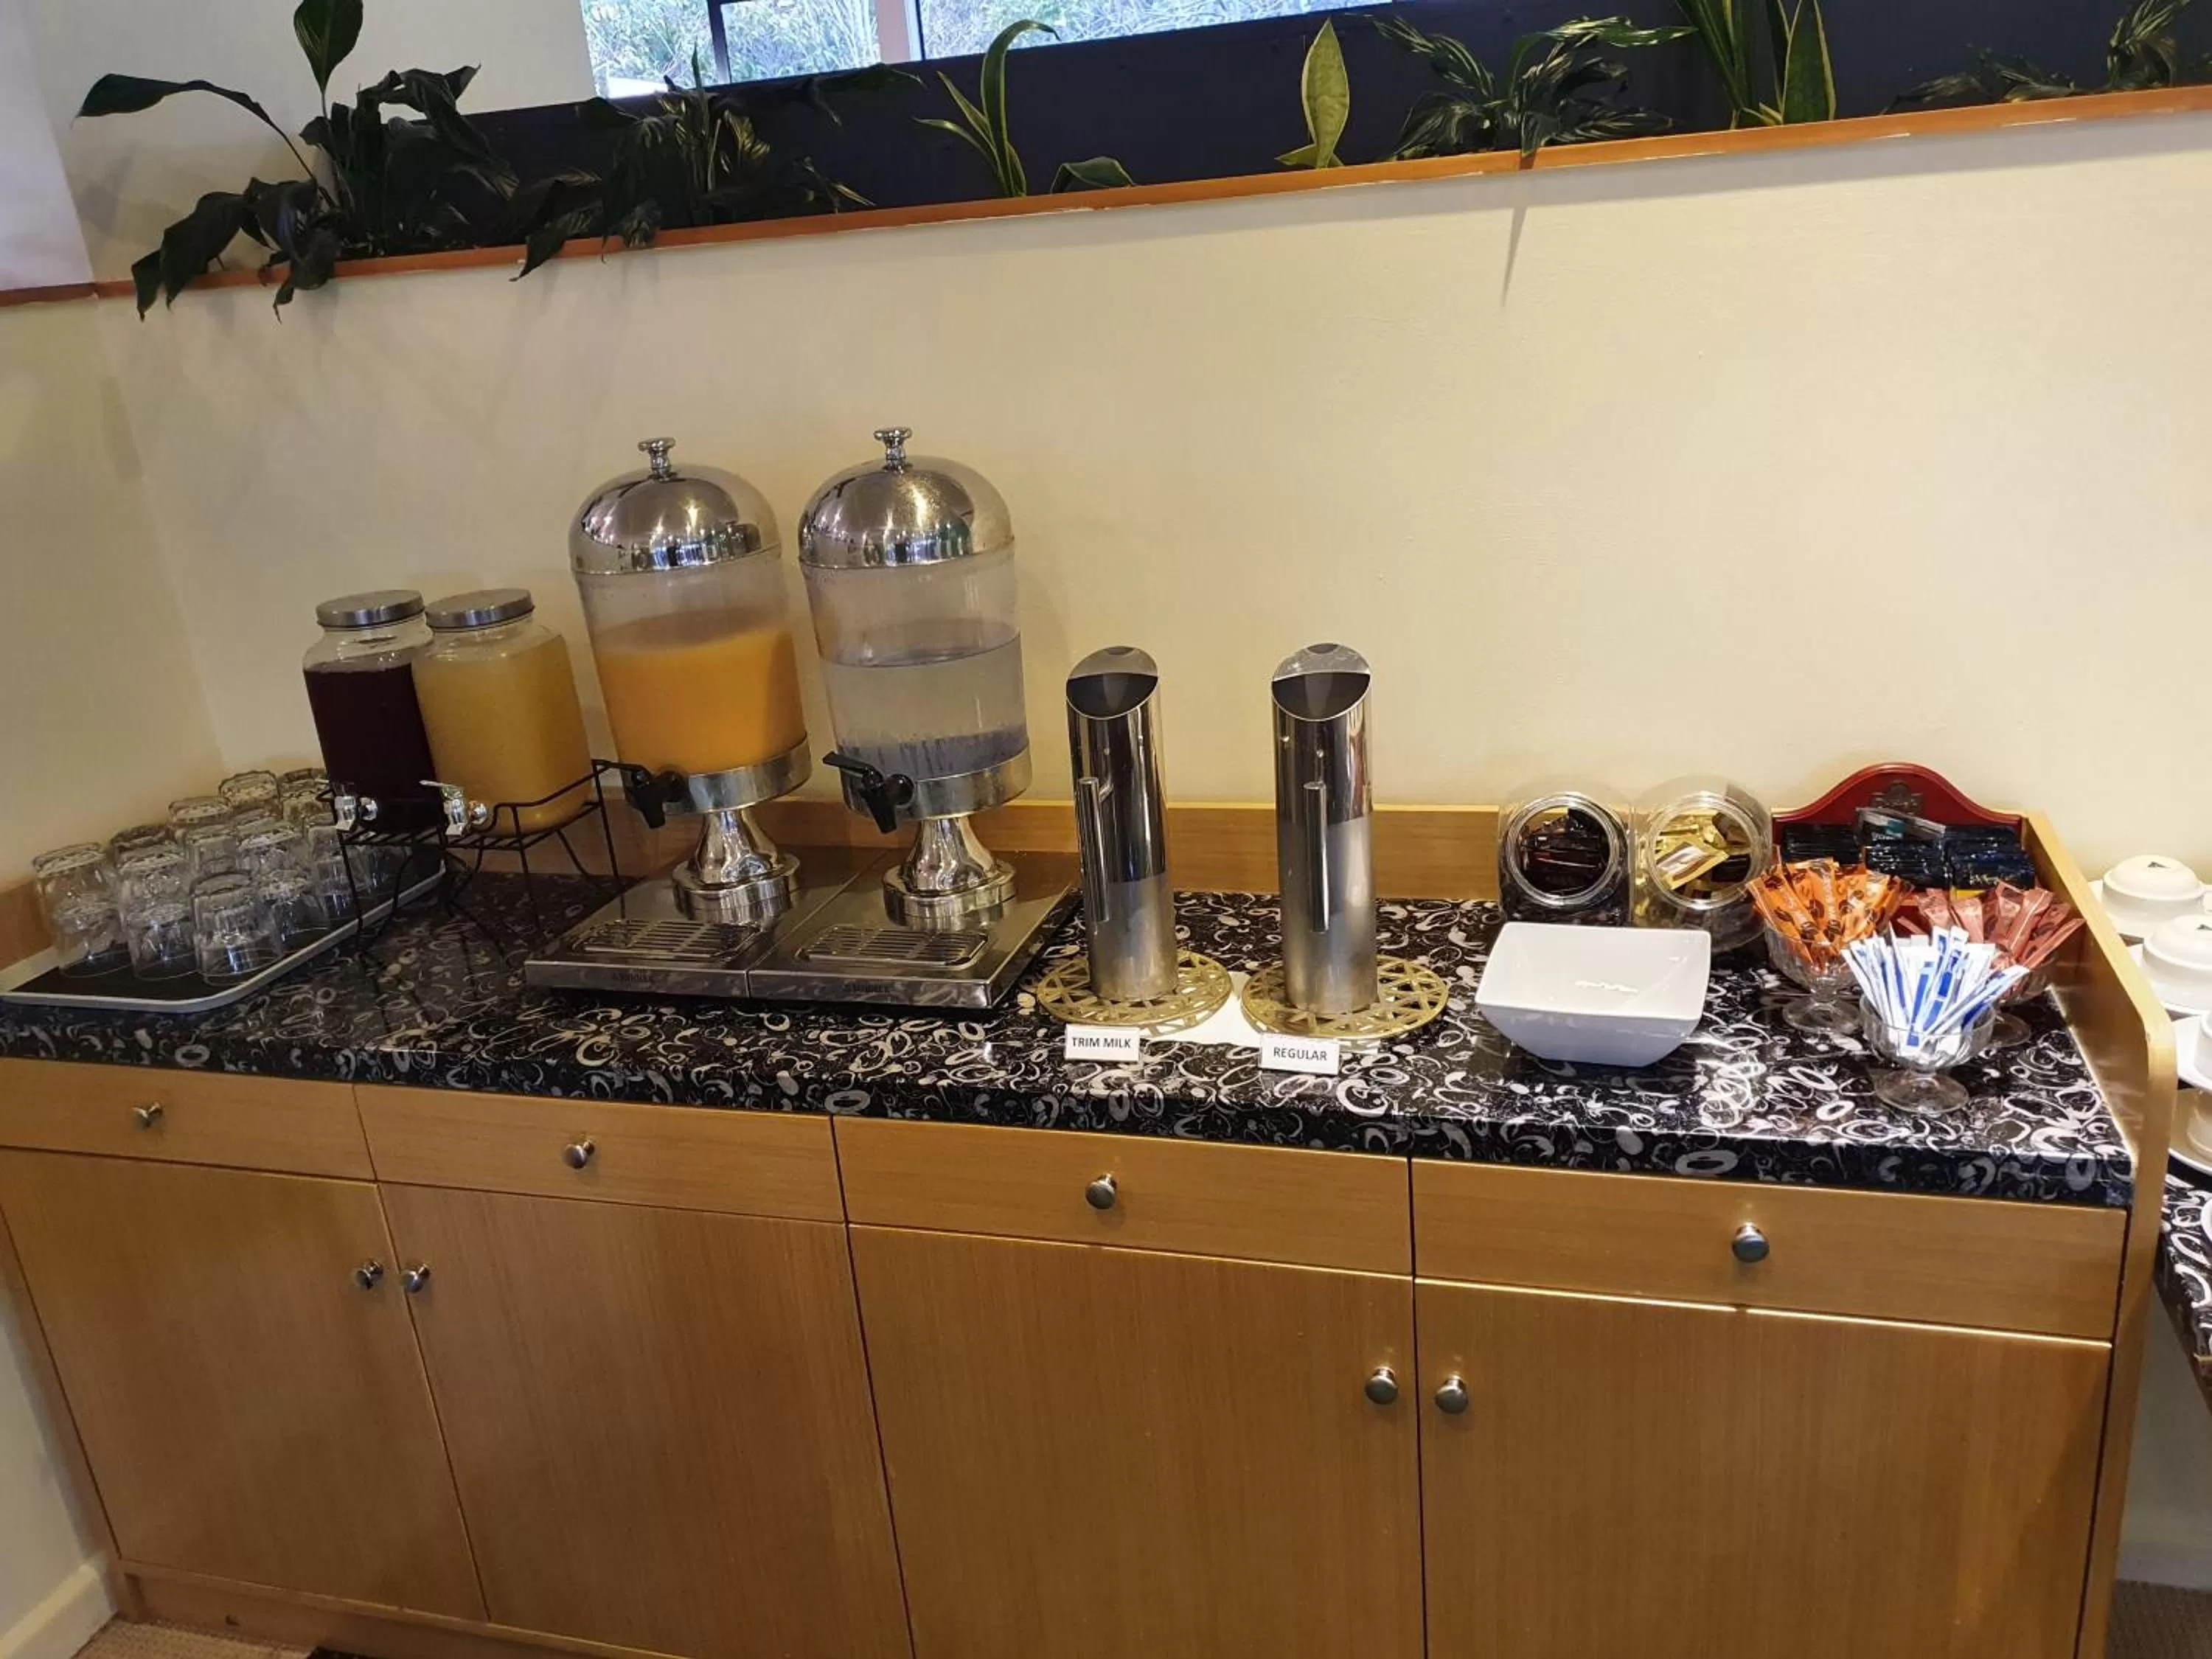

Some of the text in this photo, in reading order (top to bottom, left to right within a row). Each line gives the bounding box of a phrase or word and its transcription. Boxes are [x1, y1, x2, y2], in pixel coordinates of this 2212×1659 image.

[1072, 1037, 1131, 1048] TRIM MILK
[1273, 1047, 1328, 1060] REGULAR
